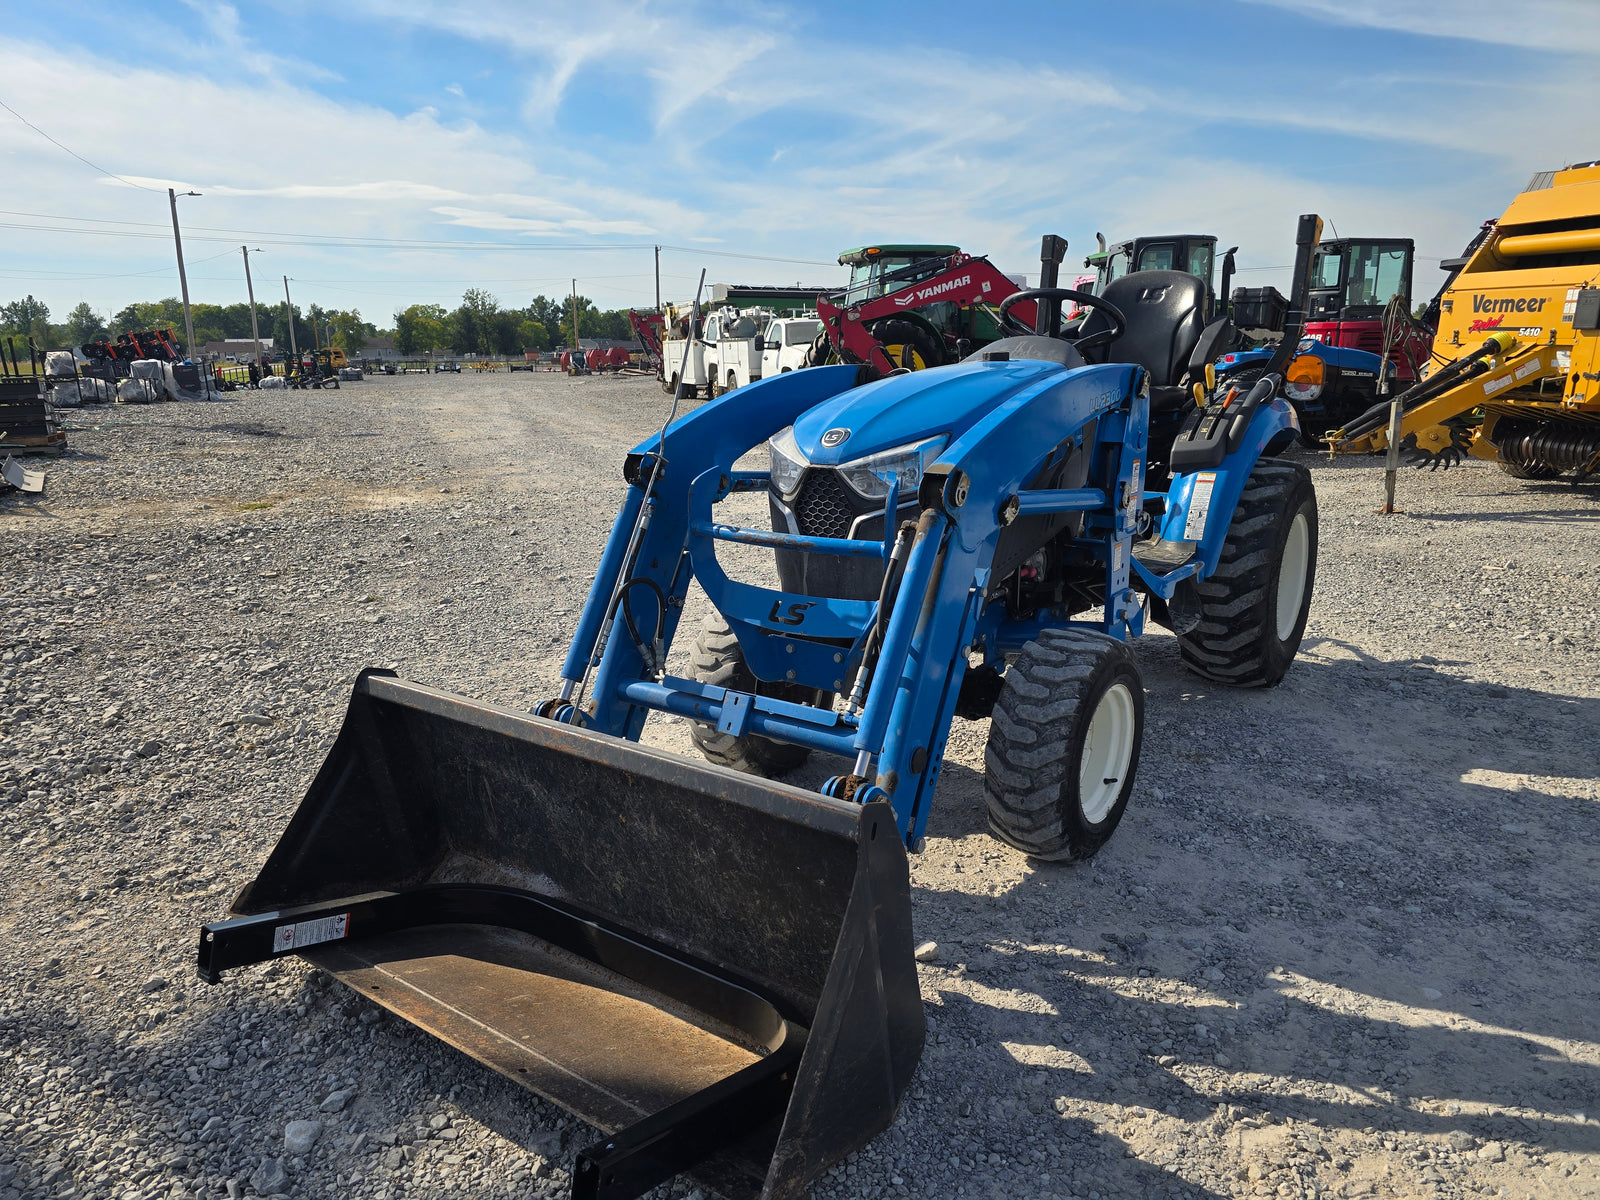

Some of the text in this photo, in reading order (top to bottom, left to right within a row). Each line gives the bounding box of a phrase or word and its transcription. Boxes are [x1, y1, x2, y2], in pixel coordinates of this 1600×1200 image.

[916, 275, 971, 300] YANMAR
[1473, 294, 1547, 313] Vermeer
[1518, 328, 1541, 337] 5410
[768, 600, 817, 626] LS
